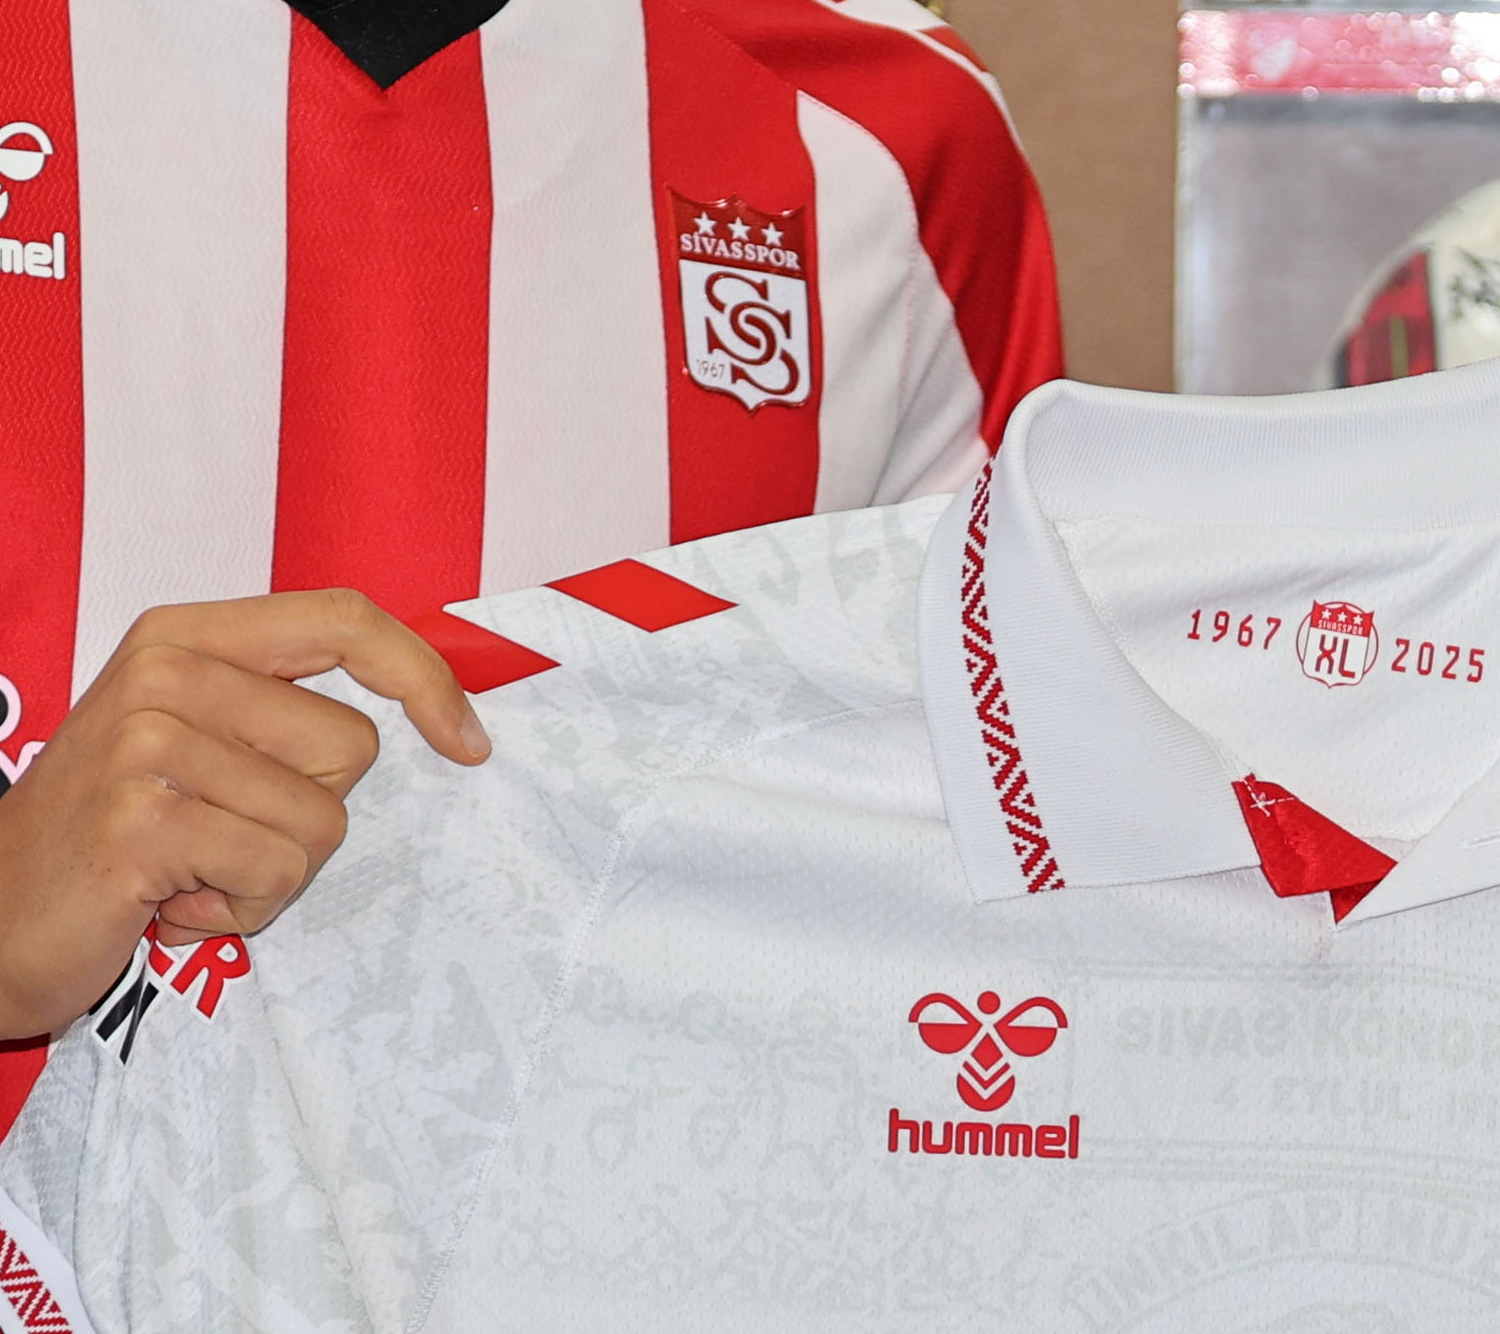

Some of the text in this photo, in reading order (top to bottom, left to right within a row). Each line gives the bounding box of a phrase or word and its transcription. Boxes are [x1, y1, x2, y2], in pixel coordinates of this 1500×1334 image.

[679, 231, 801, 270] SİVASSPOR
[1186, 608, 1283, 651] 1967
[1315, 634, 1356, 679] XL
[1390, 637, 1487, 683] 2025
[888, 1107, 1081, 1160] hummel
